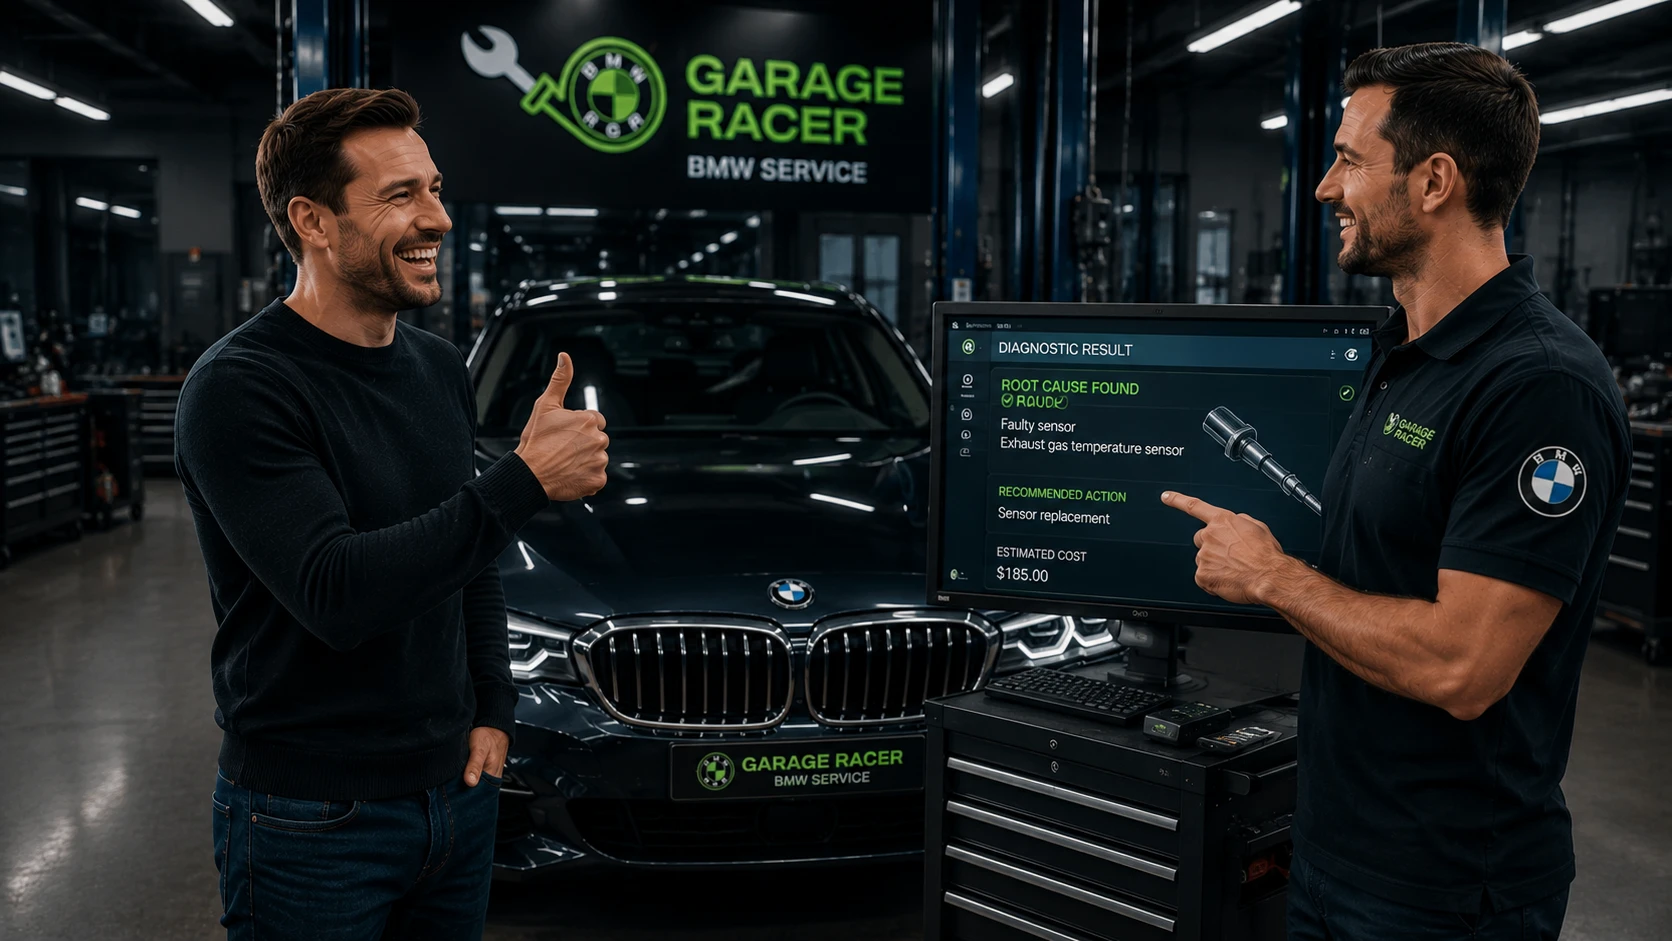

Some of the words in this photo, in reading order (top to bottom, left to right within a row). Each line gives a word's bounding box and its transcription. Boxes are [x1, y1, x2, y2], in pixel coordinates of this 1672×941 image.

[686, 54, 904, 104] GARAGE
[687, 99, 868, 145] RACER
[687, 155, 755, 180] BMW
[759, 157, 868, 184] SERVICE
[998, 341, 1079, 356] DIAGNOSTIC
[1082, 343, 1134, 357] RESULT
[1001, 378, 1040, 392] ROOT
[1042, 379, 1088, 394] CAUSE
[1091, 381, 1140, 396] FOUND
[1001, 417, 1035, 433] Faulty
[1037, 421, 1077, 433] sensor
[1399, 418, 1436, 441] GARAGE
[1000, 436, 1046, 450] Exhaust
[1048, 440, 1068, 453] gas
[1071, 440, 1142, 456] temperature
[1144, 445, 1185, 457] sensor
[1393, 429, 1427, 450] RACER
[998, 486, 1083, 500] RECOMMENDED
[1085, 490, 1127, 503] ACTION
[997, 506, 1038, 520] Sensor
[1039, 510, 1111, 525] replacement
[996, 546, 1055, 560] ESTIMATED
[1057, 550, 1088, 562] COST
[996, 565, 1049, 583] $185.00
[741, 754, 830, 772] GARAGE
[835, 750, 903, 768] RACER
[774, 774, 809, 787] BMW
[811, 771, 871, 786] SERVICE
